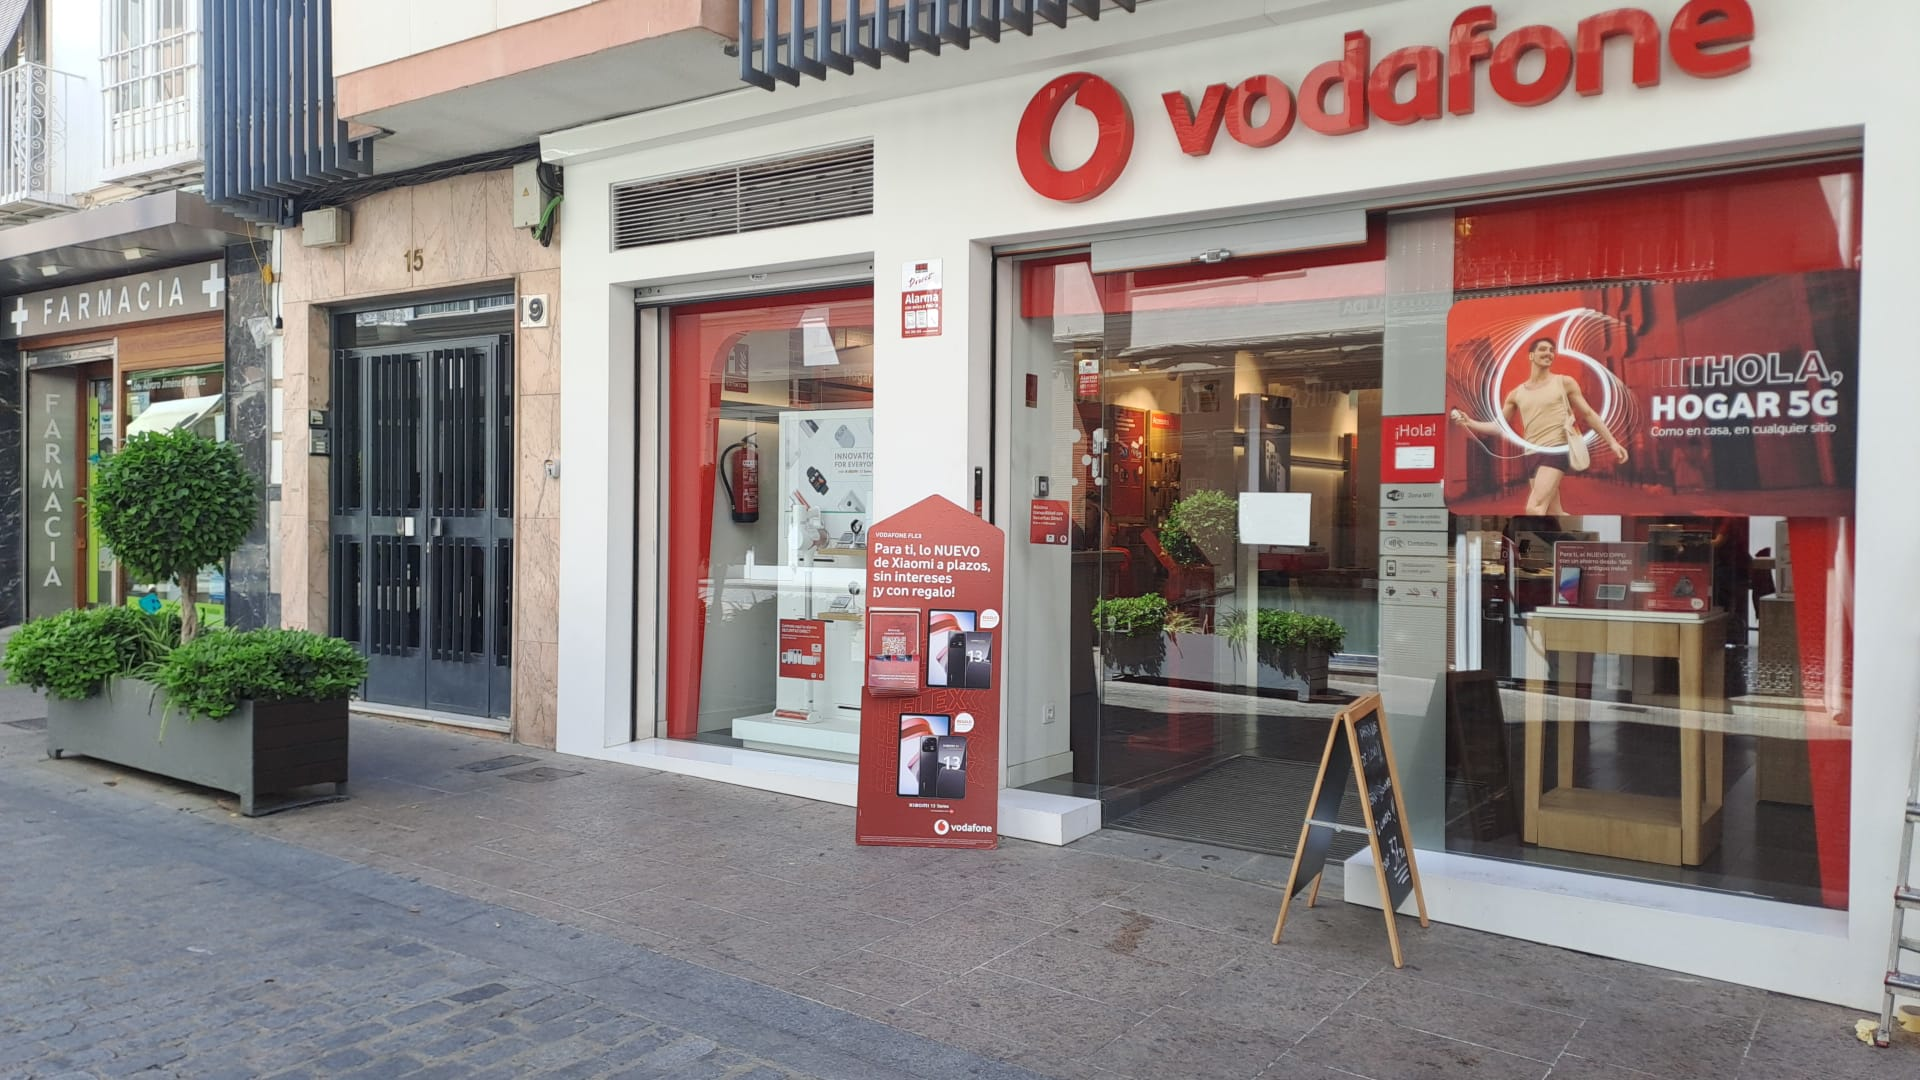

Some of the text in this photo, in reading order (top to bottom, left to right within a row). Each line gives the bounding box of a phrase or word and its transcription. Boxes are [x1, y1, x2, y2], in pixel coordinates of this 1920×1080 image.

[1161, 0, 1756, 157] vodafone
[404, 249, 424, 272] 15
[43, 276, 184, 326] FARMACIA
[904, 292, 939, 305] Alarma
[1703, 350, 1844, 387] HOLA,
[1652, 389, 1838, 421] HOGAR 5G
[1395, 423, 1436, 441] ¡Hola!
[1651, 422, 1837, 437] Como en casa, en cualquier sitio
[42, 393, 64, 587] FARMACIA
[874, 542, 980, 557] Para ti, lo NUEVO
[873, 557, 991, 573] de Xiaomi a plazos,
[873, 570, 953, 584] sin intereses
[873, 586, 956, 600] ¡y con regalo!
[967, 650, 983, 663] 13
[943, 756, 961, 770] 13
[950, 823, 992, 833] vodafone
